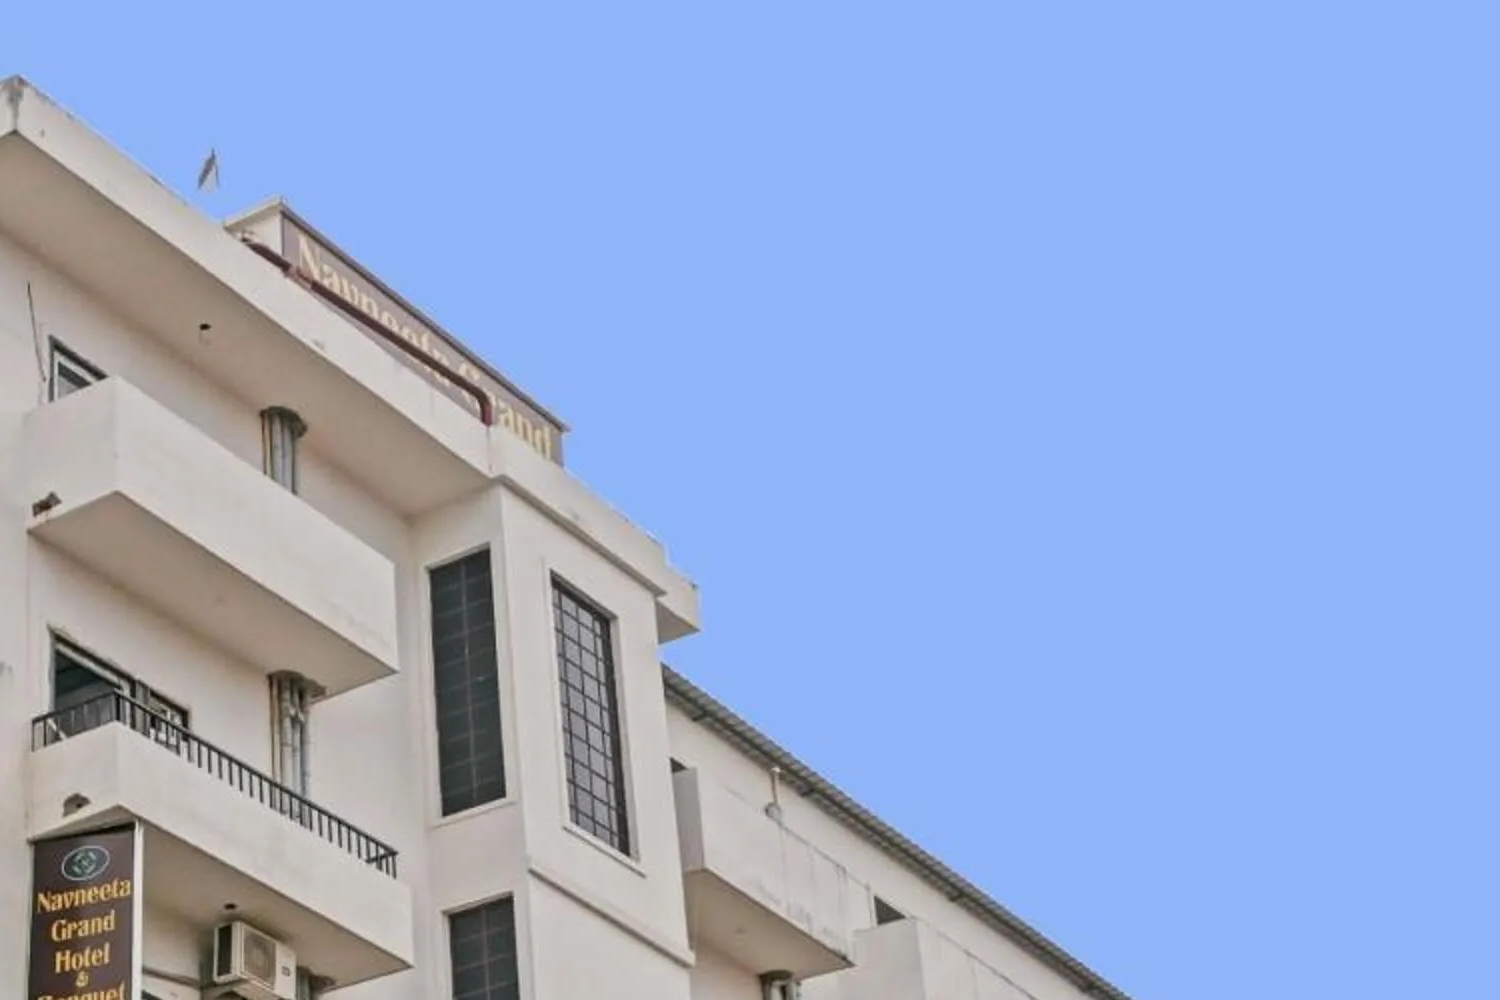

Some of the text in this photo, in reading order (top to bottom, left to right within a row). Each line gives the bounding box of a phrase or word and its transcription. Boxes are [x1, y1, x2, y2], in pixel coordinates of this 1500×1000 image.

[36, 878, 132, 913] Navneeta
[51, 909, 116, 942] Grand
[55, 942, 110, 973] Hotel
[75, 971, 89, 988] &
